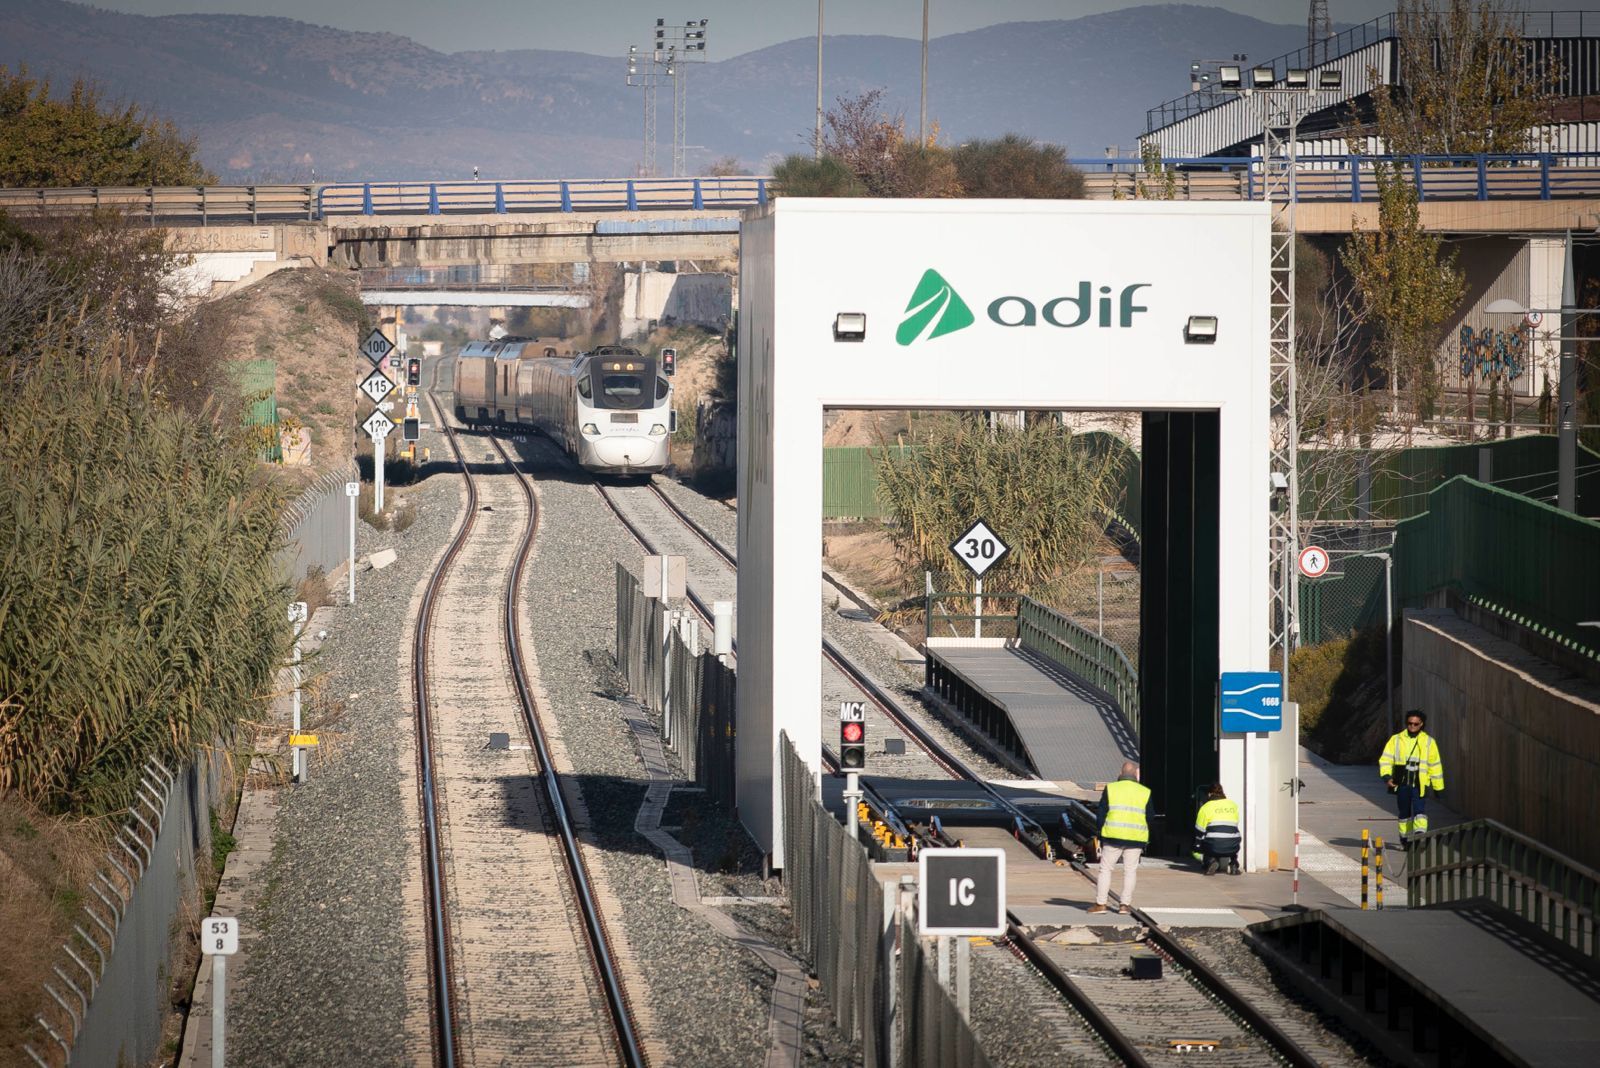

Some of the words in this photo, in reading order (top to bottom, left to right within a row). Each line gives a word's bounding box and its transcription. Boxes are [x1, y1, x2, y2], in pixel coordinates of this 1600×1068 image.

[987, 281, 1152, 328] adif
[368, 340, 386, 353] 100
[368, 380, 387, 393] 115
[965, 538, 995, 559] 30
[840, 702, 865, 721] MC1
[949, 877, 976, 907] IC
[211, 922, 229, 934] 53
[215, 938, 224, 950] 8
